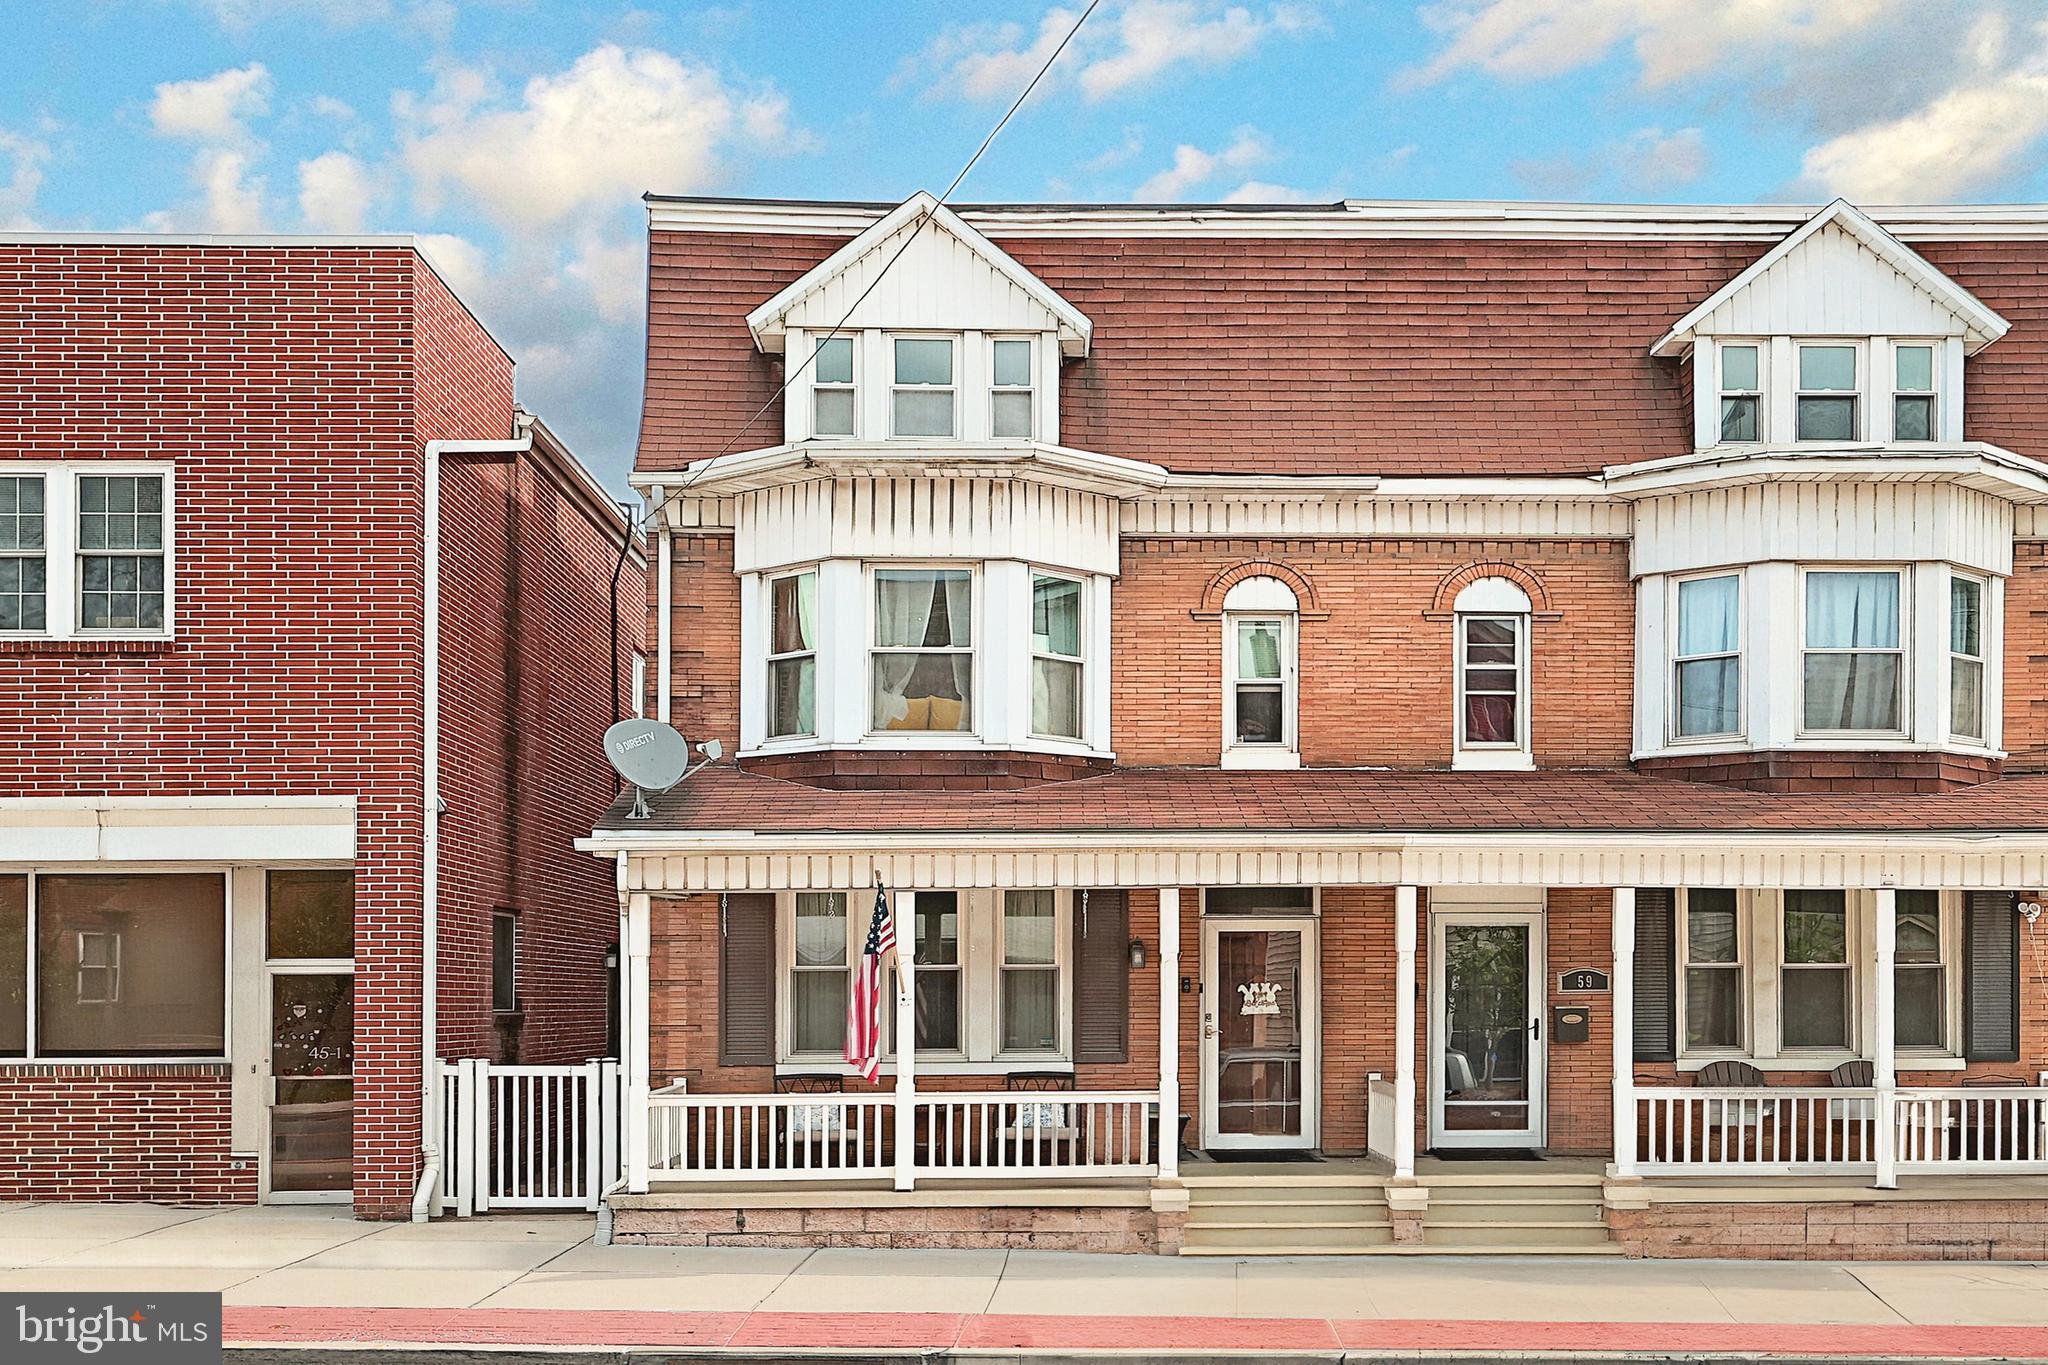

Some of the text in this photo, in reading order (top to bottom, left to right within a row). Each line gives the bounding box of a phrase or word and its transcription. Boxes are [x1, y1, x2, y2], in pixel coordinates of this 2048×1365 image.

[622, 731, 656, 751] DIRECTV
[1577, 975, 1593, 988] 59
[308, 1047, 341, 1059] 45-1
